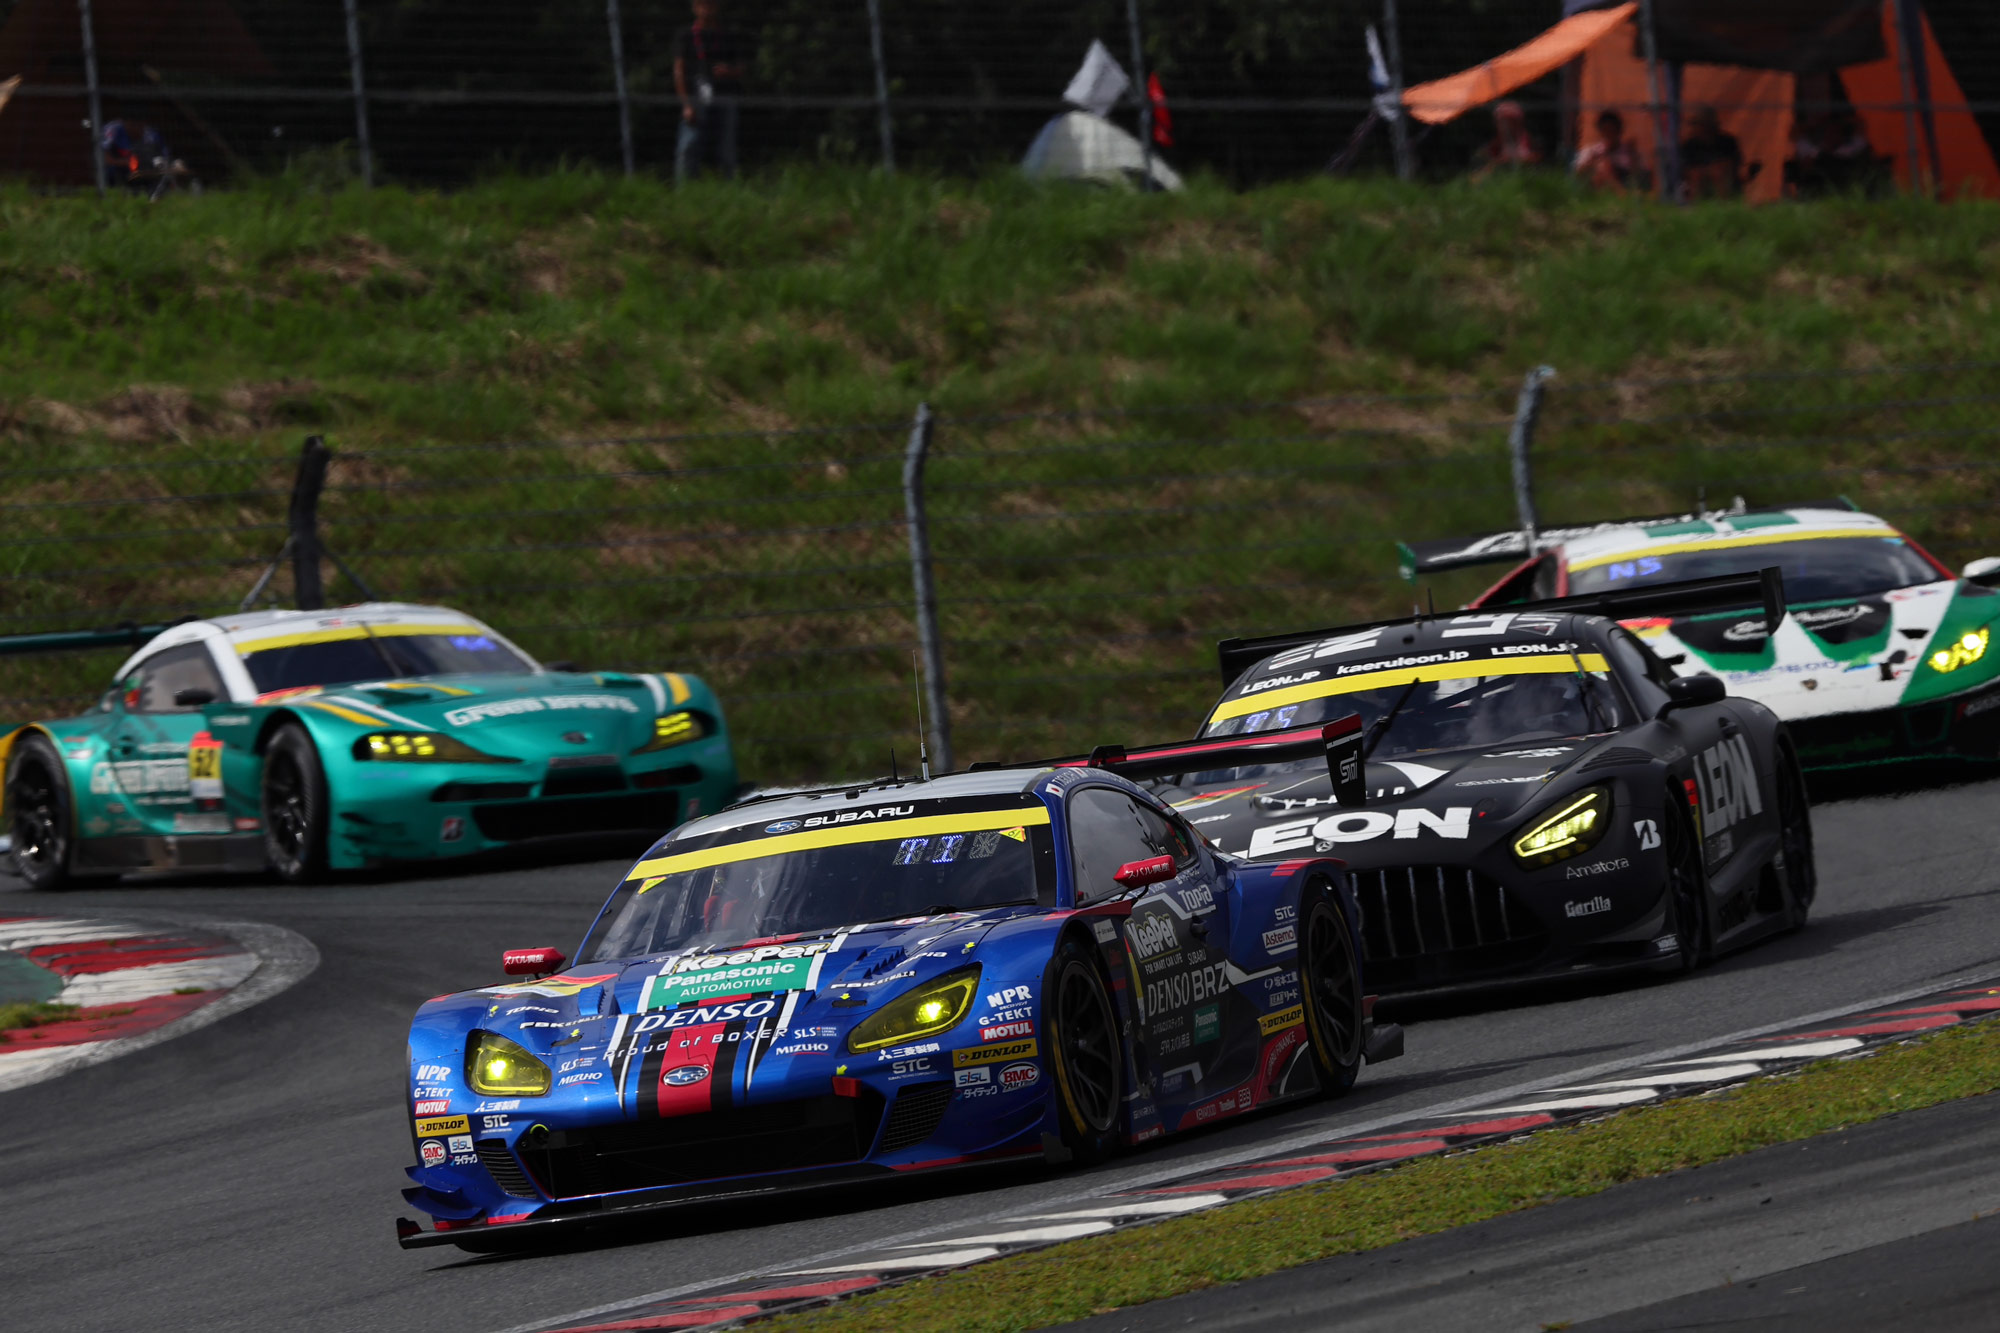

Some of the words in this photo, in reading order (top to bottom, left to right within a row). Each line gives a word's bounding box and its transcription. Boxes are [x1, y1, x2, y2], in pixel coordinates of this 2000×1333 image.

[1335, 649, 1469, 675] kaeruleon.jp
[1692, 733, 1763, 839] LEON
[803, 804, 915, 828] SUBARU
[1211, 806, 1473, 859] EON
[1566, 857, 1630, 880] Amatora
[1274, 905, 1295, 921] STC
[1564, 896, 1611, 918] Gorilla
[1265, 928, 1295, 947] Astemo
[1187, 949, 1207, 966] SUBARU
[663, 962, 796, 990] Panasonic
[680, 977, 773, 998] AUTOMOTIVE
[986, 985, 1033, 1008] NPR
[1147, 972, 1190, 1017] DENSO
[1191, 961, 1230, 1002] BRZ
[634, 1000, 776, 1033] DENSO
[978, 1006, 1032, 1026] G-TEKT
[1267, 1009, 1302, 1029] DUNLOP
[679, 1035, 702, 1048] of
[711, 1027, 788, 1044] BOXER
[794, 1027, 816, 1039] SLS
[983, 1022, 1032, 1041] MOTUL
[775, 1043, 829, 1055] MIZUHO
[891, 1042, 941, 1059] 三菱製鋼
[970, 1043, 1032, 1061] DUNLOP
[416, 1065, 452, 1082] NPR
[558, 1058, 580, 1074] SLS
[892, 1057, 931, 1075] STC
[1003, 1067, 1036, 1083] BMC
[558, 1072, 603, 1086] MIZUHO
[414, 1087, 454, 1099] G-TEKT
[963, 1085, 998, 1099] ダイテック
[416, 1101, 447, 1114] MOTUL
[425, 1120, 464, 1132] DUNLOP
[483, 1114, 511, 1129] STC
[423, 1147, 443, 1159] BMC
